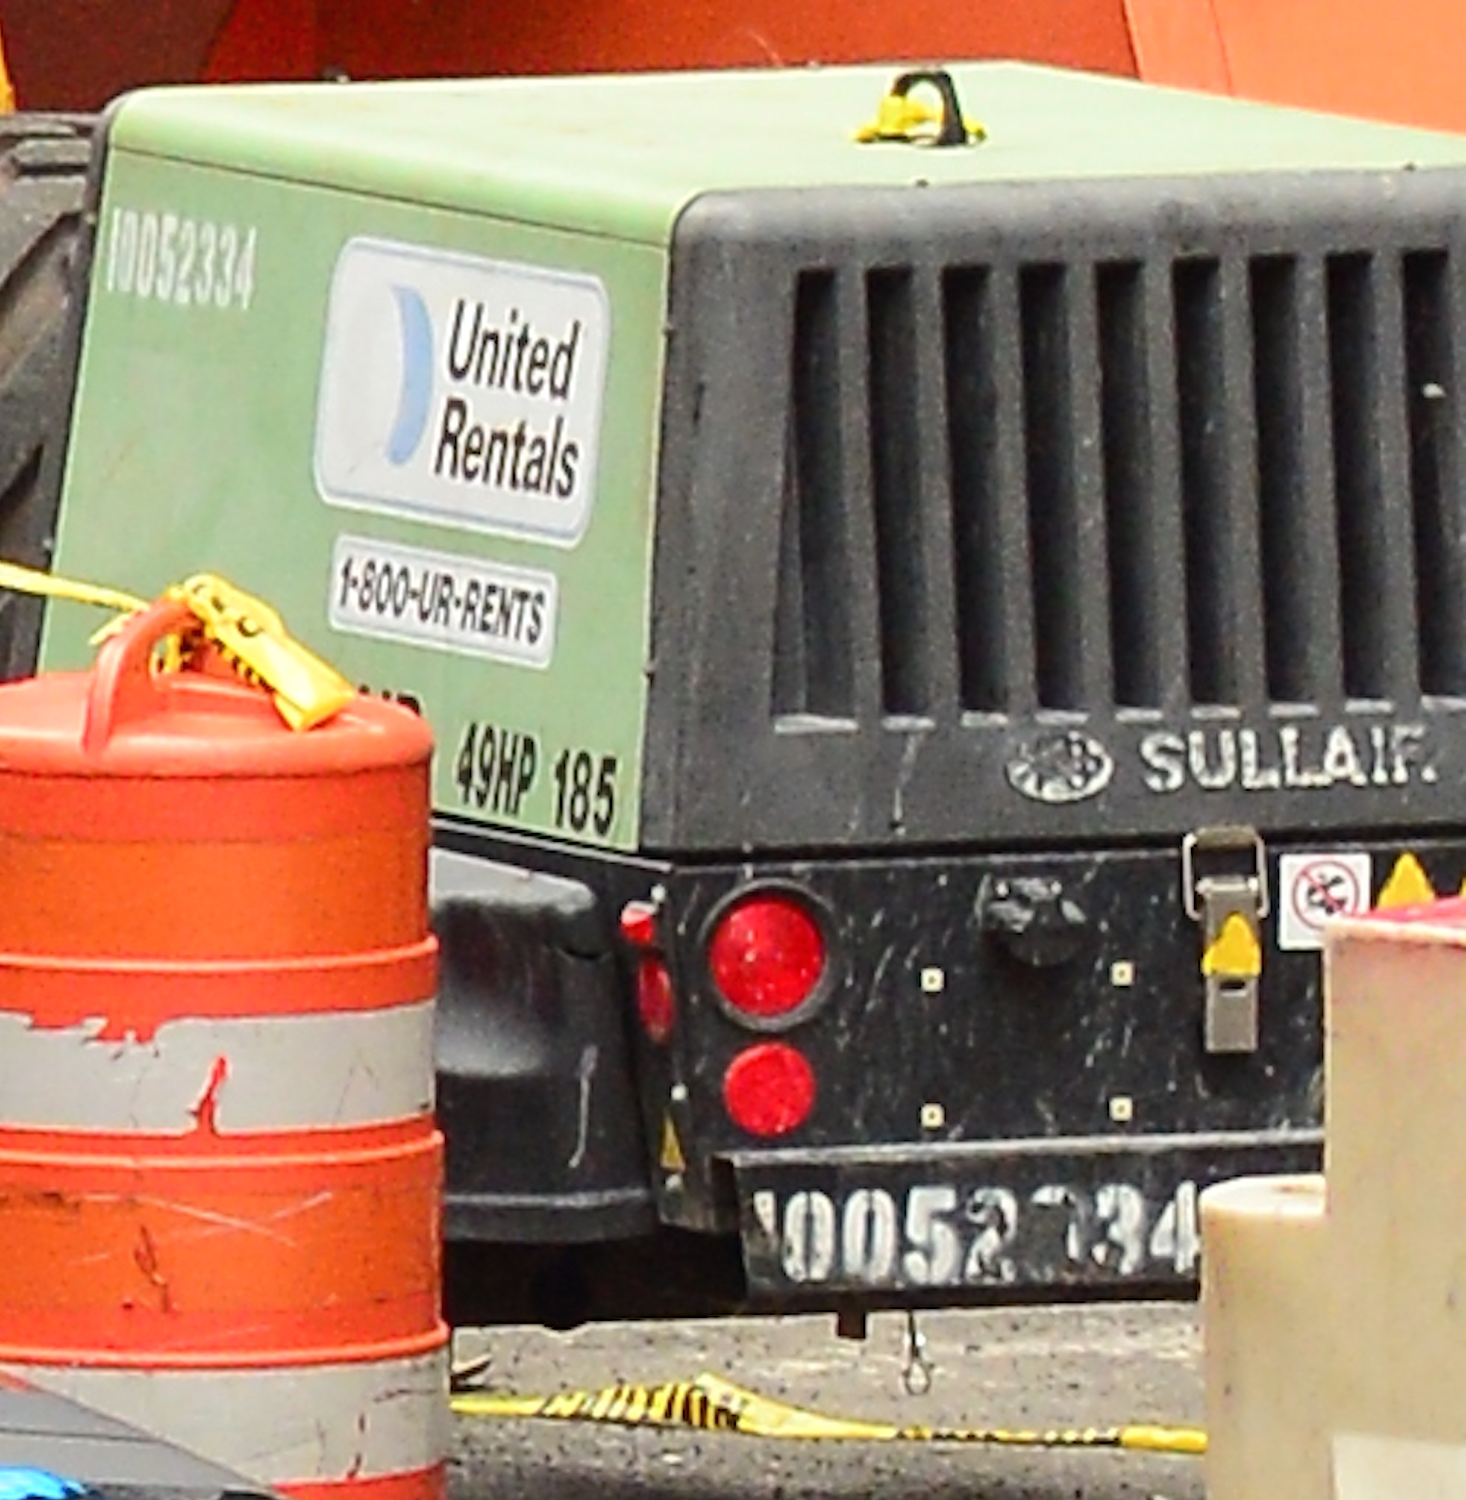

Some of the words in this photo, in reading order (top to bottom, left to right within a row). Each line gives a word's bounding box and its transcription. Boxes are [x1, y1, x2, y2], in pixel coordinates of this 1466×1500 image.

[447, 299, 581, 401] United
[434, 399, 579, 499] Rentals
[340, 556, 546, 644] 1-800-UR-RENTS
[456, 721, 538, 817] 49HP
[554, 747, 619, 837] 185
